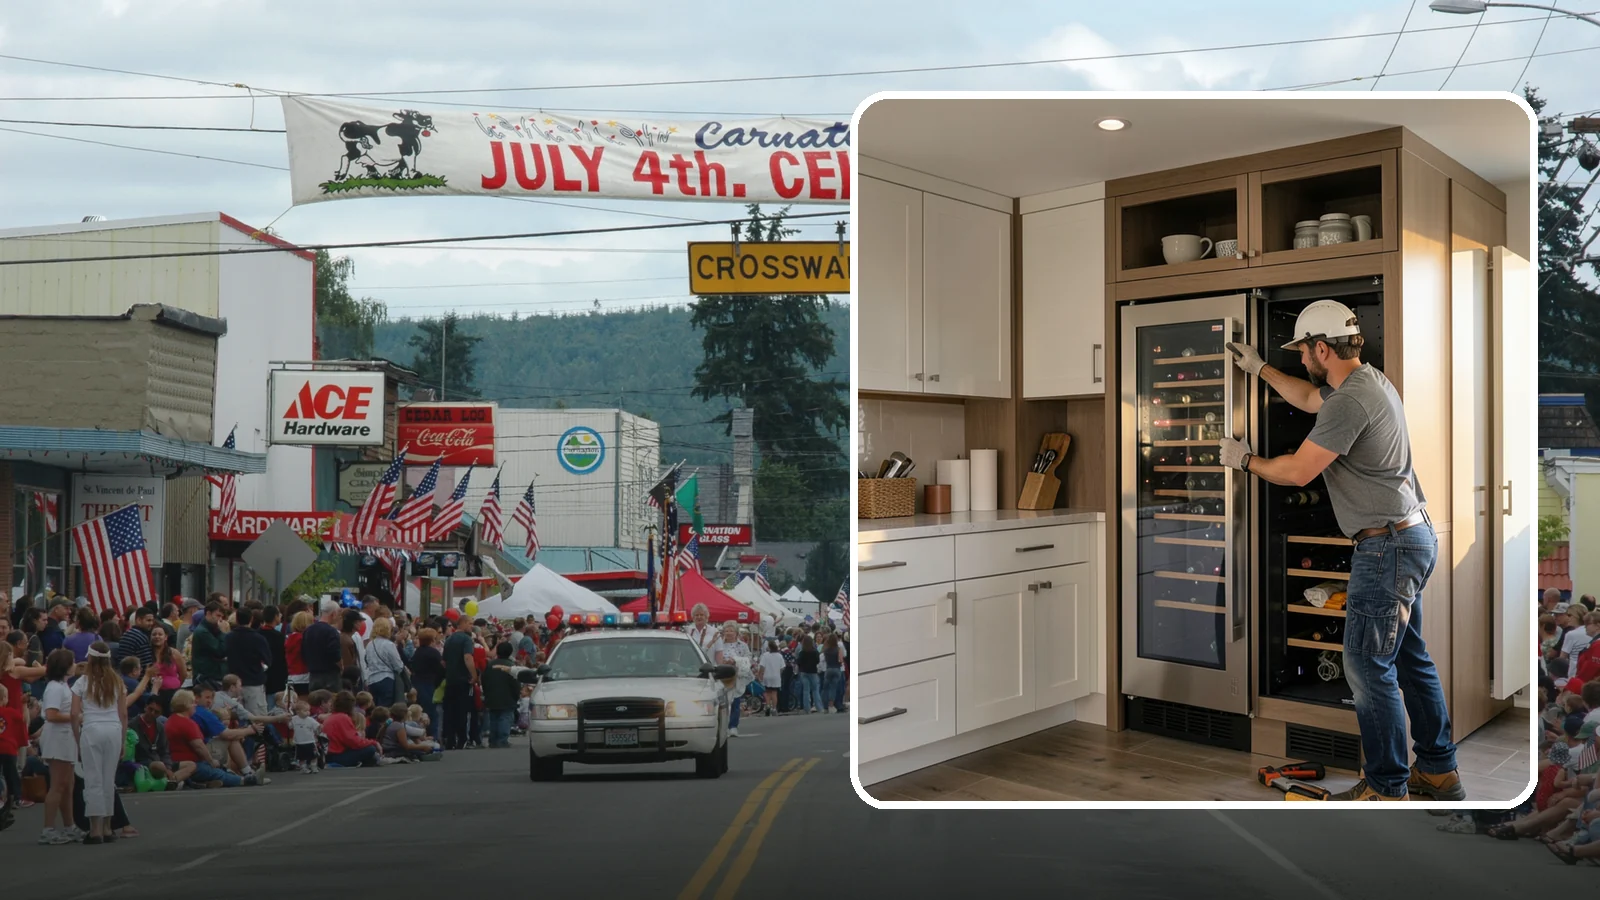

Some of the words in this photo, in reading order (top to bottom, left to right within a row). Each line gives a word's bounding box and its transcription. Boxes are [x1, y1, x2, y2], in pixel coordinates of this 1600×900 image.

[481, 141, 605, 193] JULY
[632, 150, 746, 198] 4th.
[697, 254, 850, 280] CROSSWA
[283, 380, 373, 420] ACE
[405, 409, 453, 422] CEDAR
[284, 421, 370, 436] Hardware
[416, 428, 477, 447] Coca-Cola
[353, 467, 386, 480] Simpl
[83, 485, 93, 494] St.
[96, 485, 124, 495] Vincent
[126, 485, 136, 495] de
[137, 486, 155, 495] Paul
[212, 516, 331, 535] HARDARE
[688, 526, 741, 535] CRNATION
[699, 535, 730, 543] GLASS
